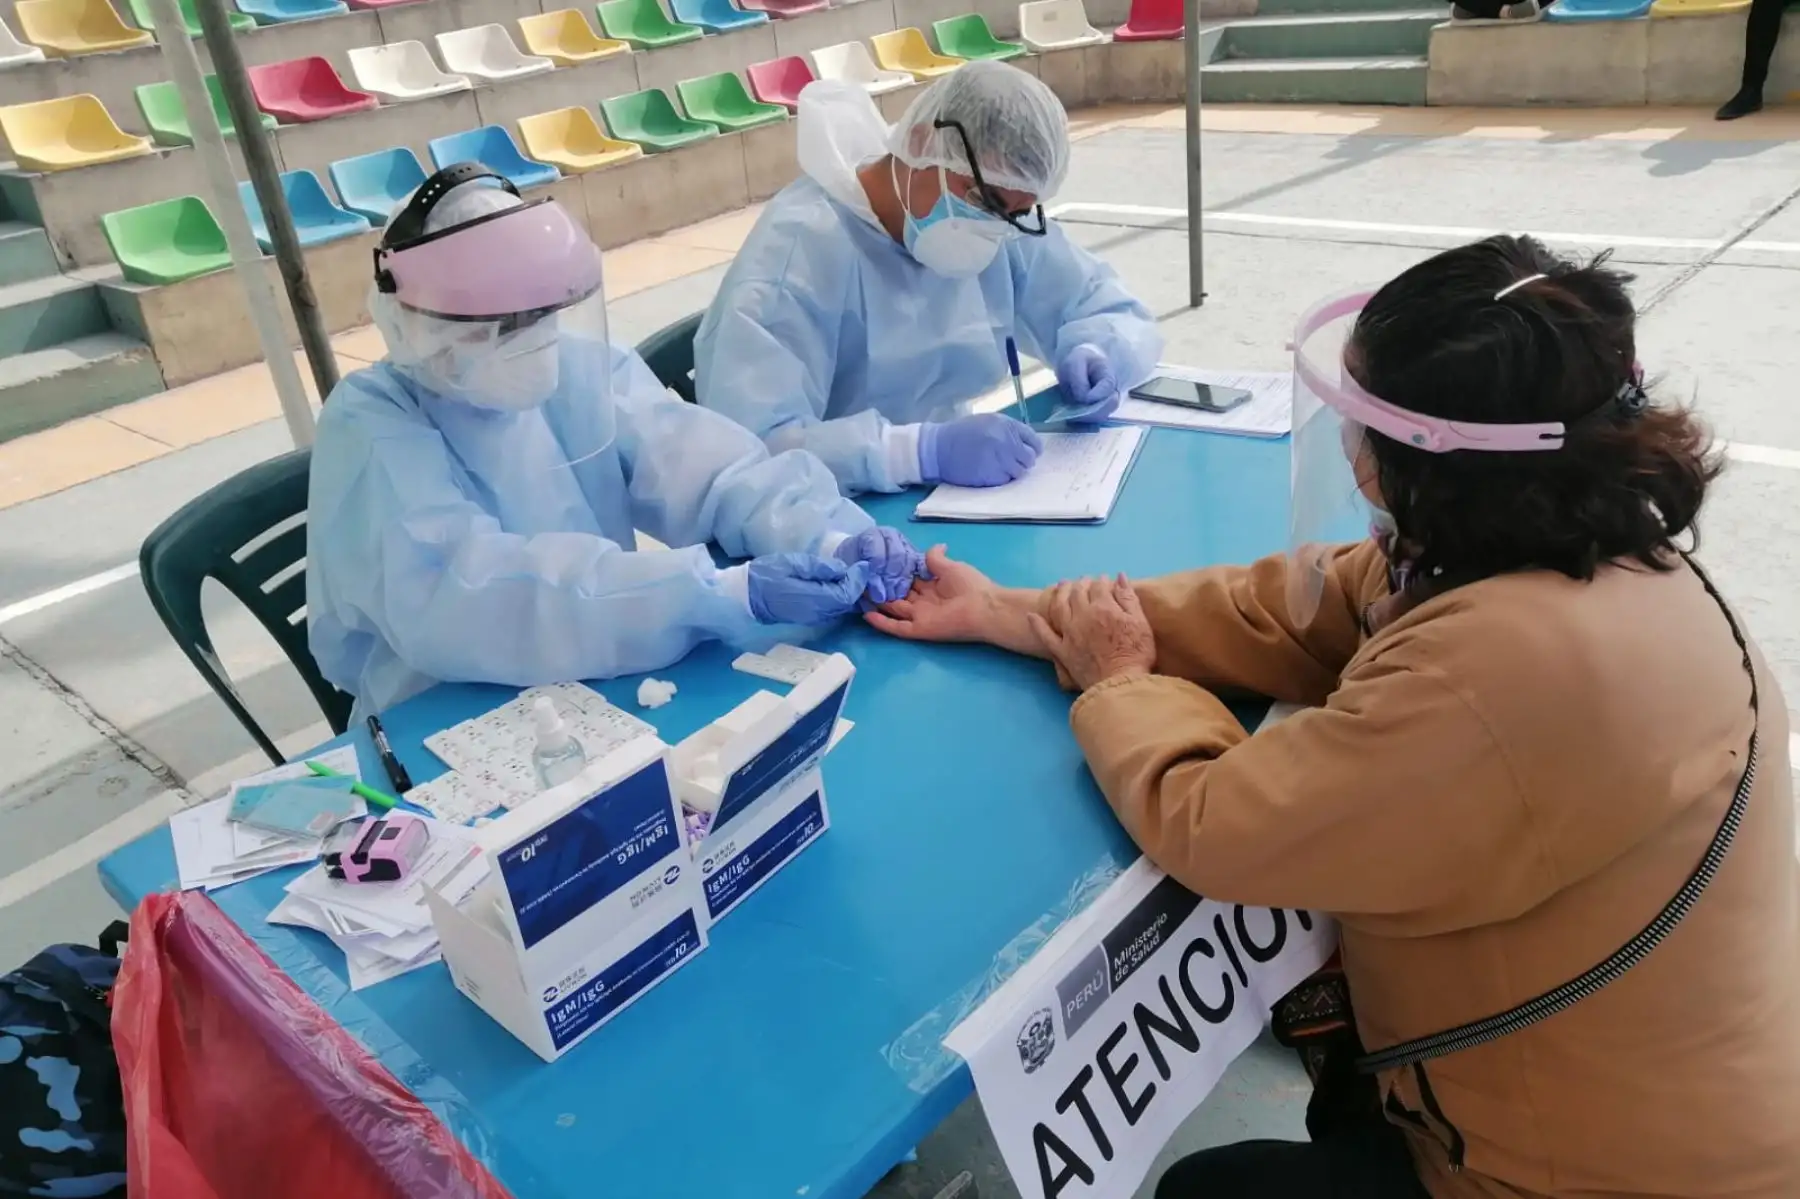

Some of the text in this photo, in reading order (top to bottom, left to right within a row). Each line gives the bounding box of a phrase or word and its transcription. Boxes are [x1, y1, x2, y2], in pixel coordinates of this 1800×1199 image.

[708, 854, 750, 893] IgM/IgG
[1114, 913, 1168, 969] Ministerio
[1115, 931, 1160, 982] de Salud
[551, 980, 605, 1023] IgM/IgG
[1066, 970, 1104, 1019] PERÚ
[1033, 904, 1313, 1199] ATENCIO
